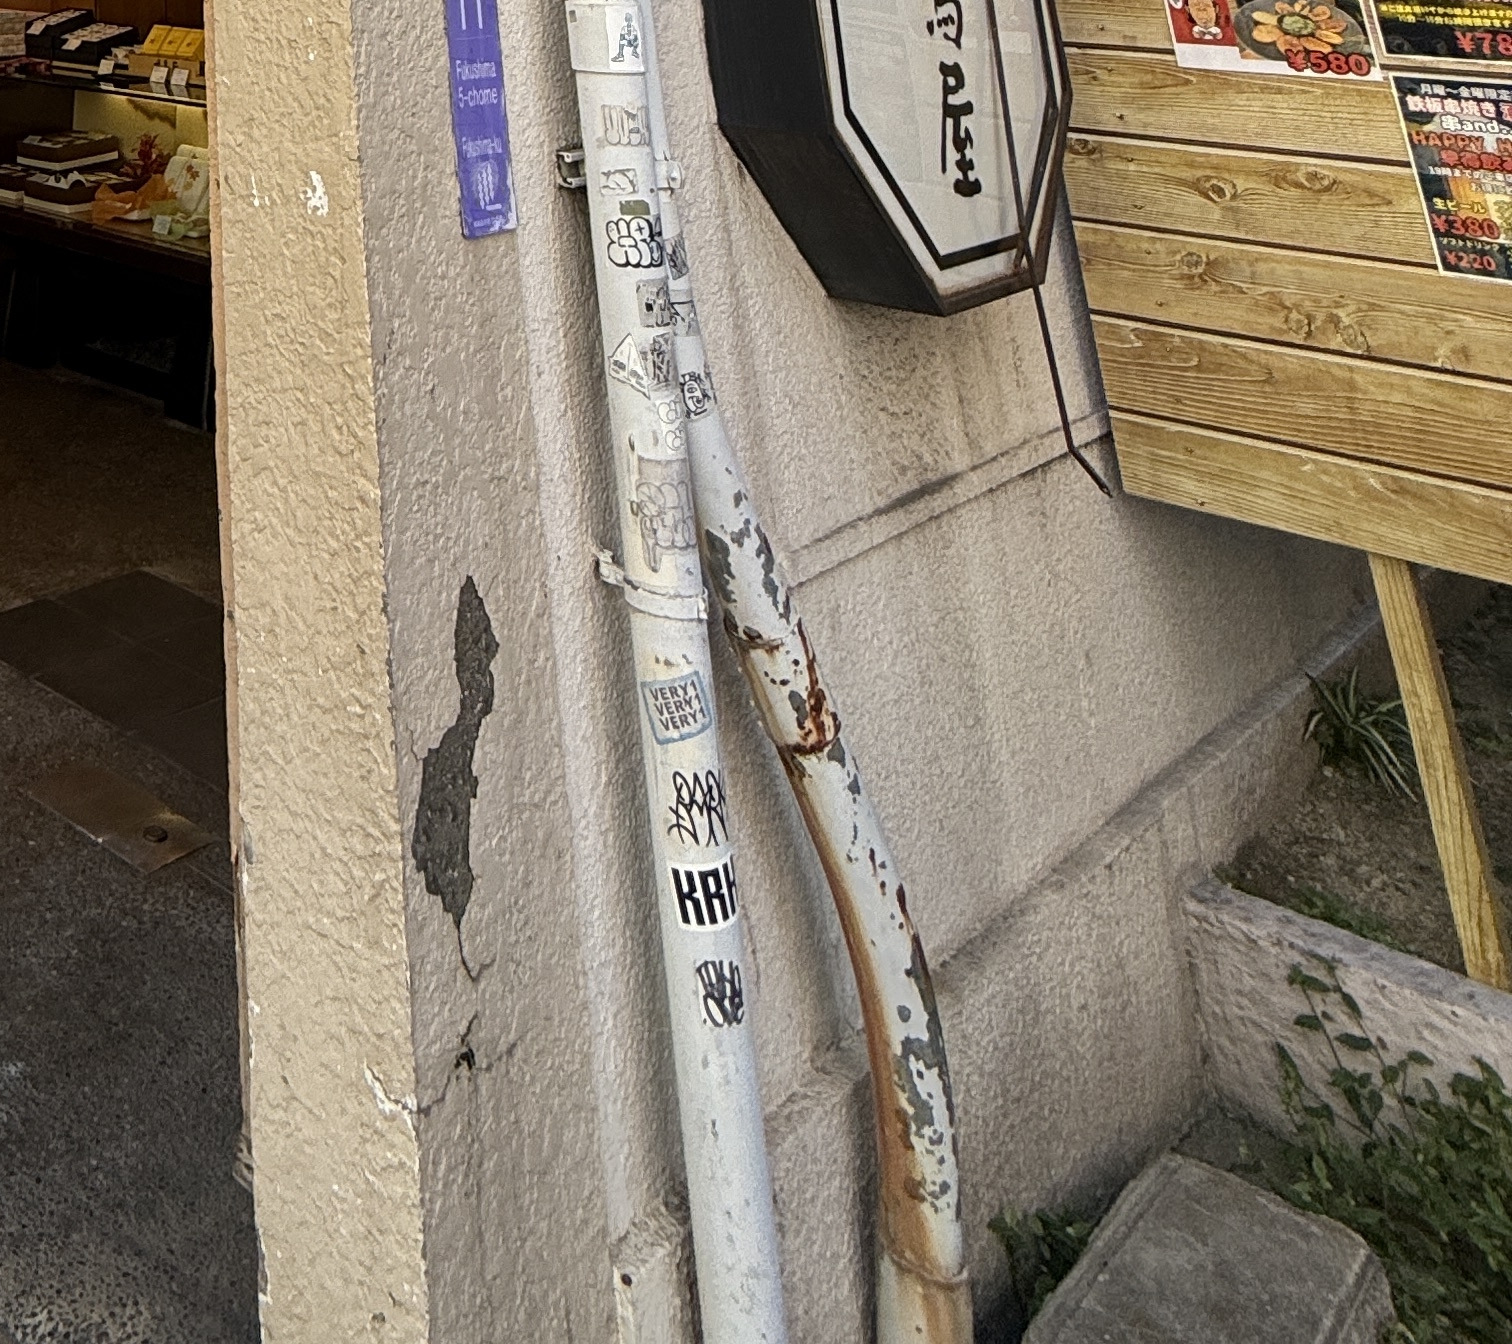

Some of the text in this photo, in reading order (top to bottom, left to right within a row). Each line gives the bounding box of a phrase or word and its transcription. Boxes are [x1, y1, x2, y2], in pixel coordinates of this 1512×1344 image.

[456, 57, 496, 81] Fukushima
[1285, 48, 1372, 77] ¥580
[458, 85, 498, 108] 5-chome
[1410, 130, 1484, 152] HAPPY
[1432, 197, 1486, 214] 生ビール
[1431, 212, 1501, 240] ¥380
[1443, 249, 1497, 271] ¥220
[649, 679, 698, 703] VERY1
[654, 692, 703, 718] VERY1
[659, 708, 708, 733] VERY1
